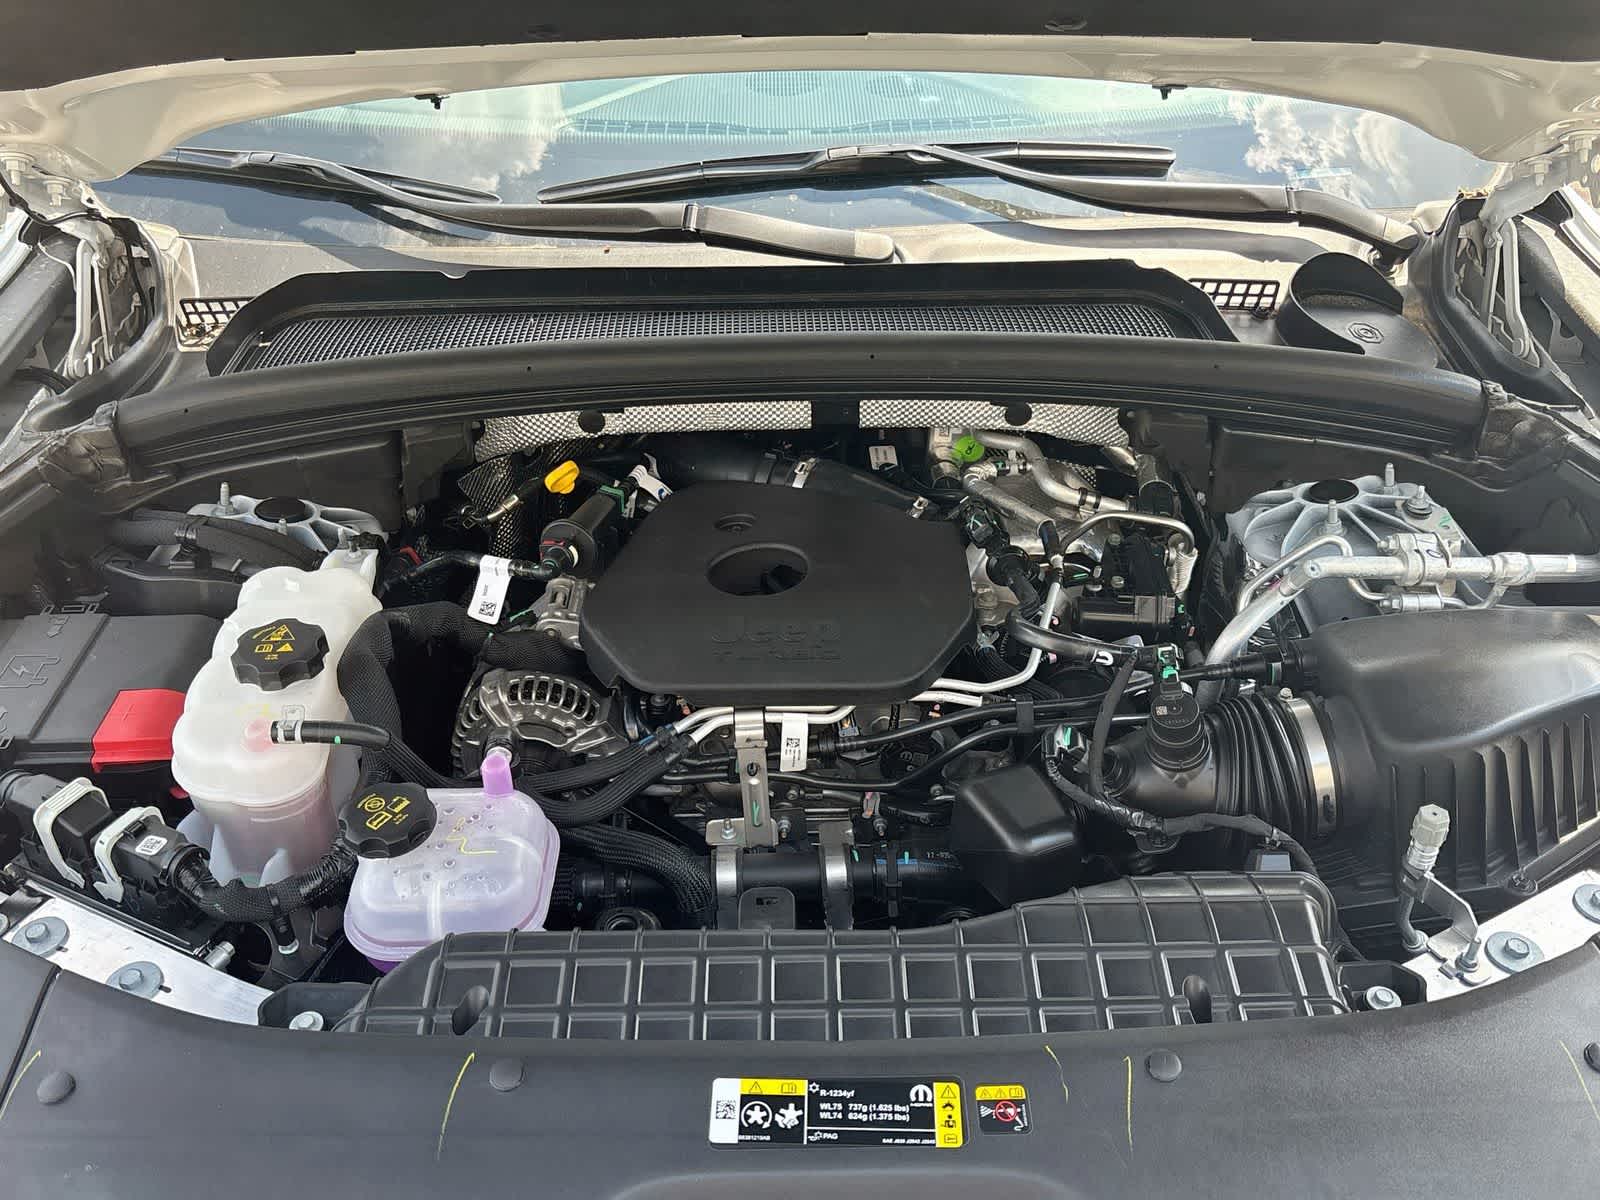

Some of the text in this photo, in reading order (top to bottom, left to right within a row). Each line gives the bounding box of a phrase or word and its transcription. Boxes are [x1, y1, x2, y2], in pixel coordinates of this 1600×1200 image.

[819, 1089, 855, 1098] R-1234yf
[847, 1103, 868, 1112] 737g
[894, 1104, 910, 1113] lbs)
[847, 1112, 868, 1121] 624g
[869, 1113, 893, 1121] (1.375
[894, 1113, 910, 1122] lbs)
